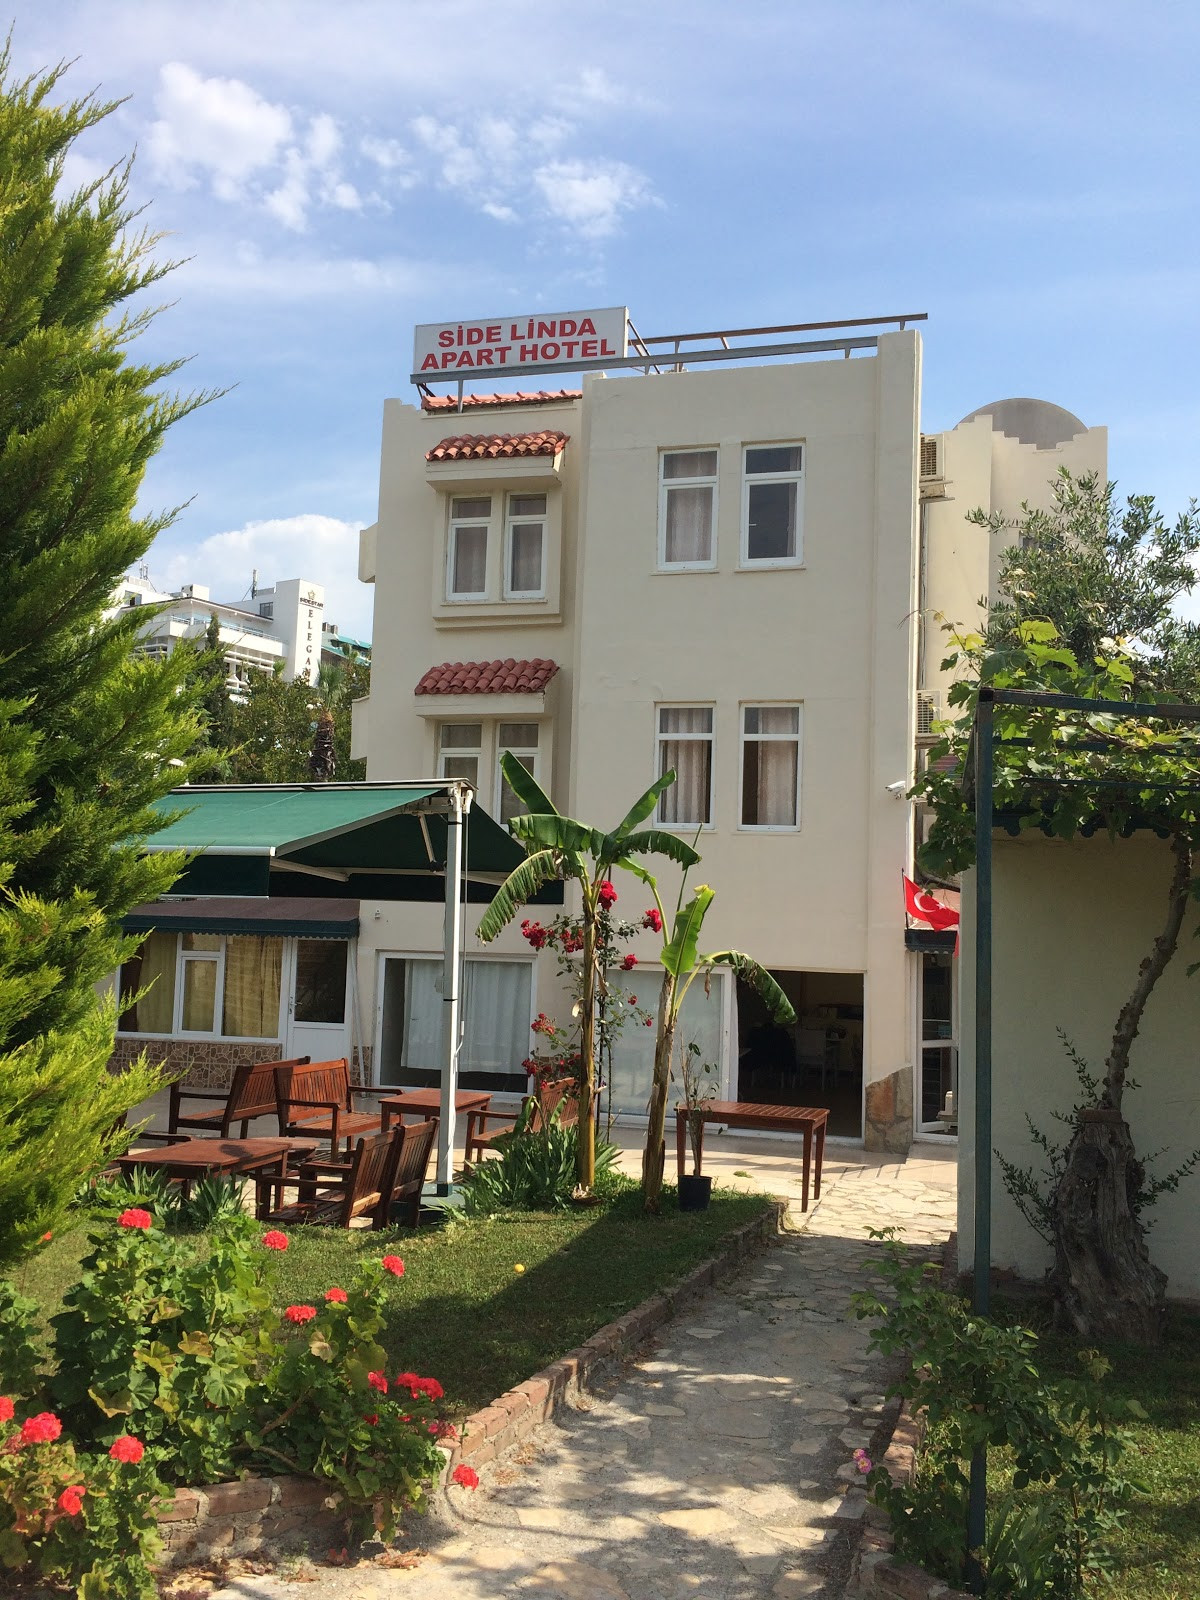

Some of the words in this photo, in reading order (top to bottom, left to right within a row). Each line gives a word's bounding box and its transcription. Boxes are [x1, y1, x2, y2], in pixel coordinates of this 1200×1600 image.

[438, 325, 502, 348] SİDE
[510, 318, 597, 341] LİNDA
[420, 346, 512, 370] APART
[519, 339, 616, 362] HOTEL
